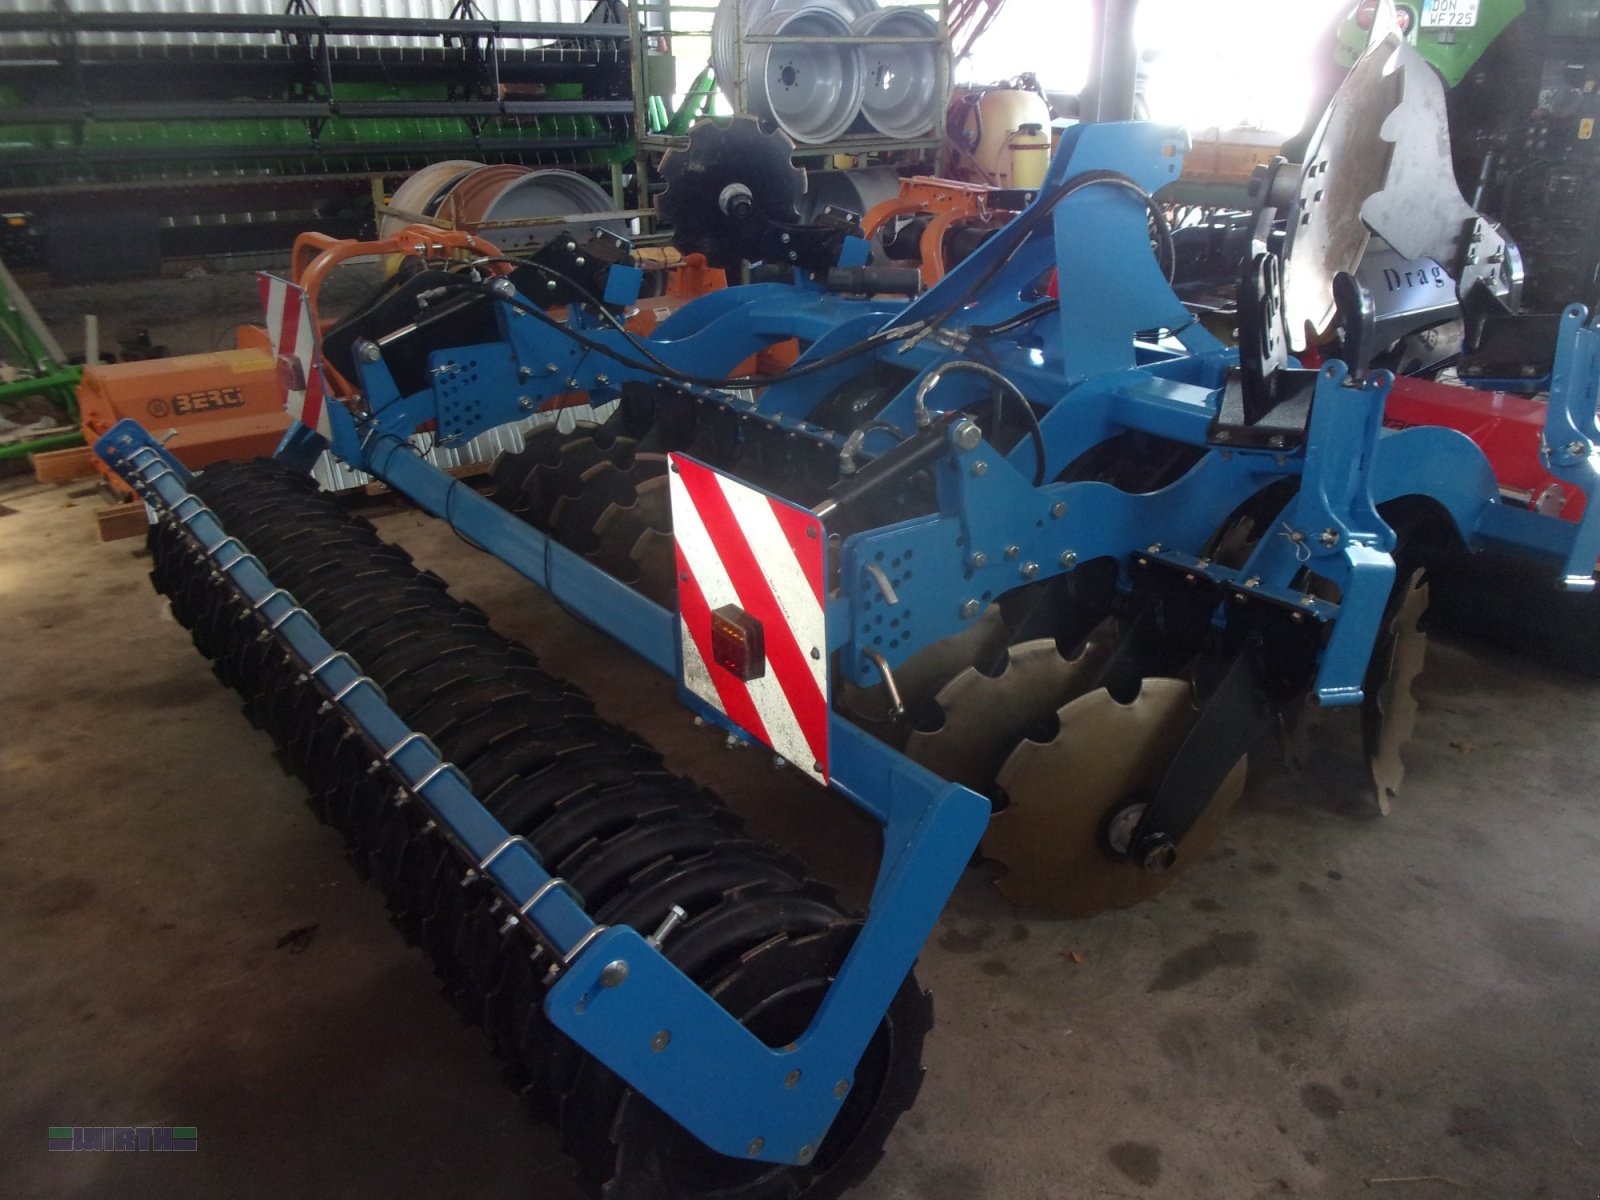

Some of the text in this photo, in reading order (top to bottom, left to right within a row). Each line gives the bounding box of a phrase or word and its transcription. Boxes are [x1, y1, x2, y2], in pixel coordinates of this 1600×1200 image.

[1432, 0, 1457, 11] DON
[1430, 12, 1473, 25] WF 725
